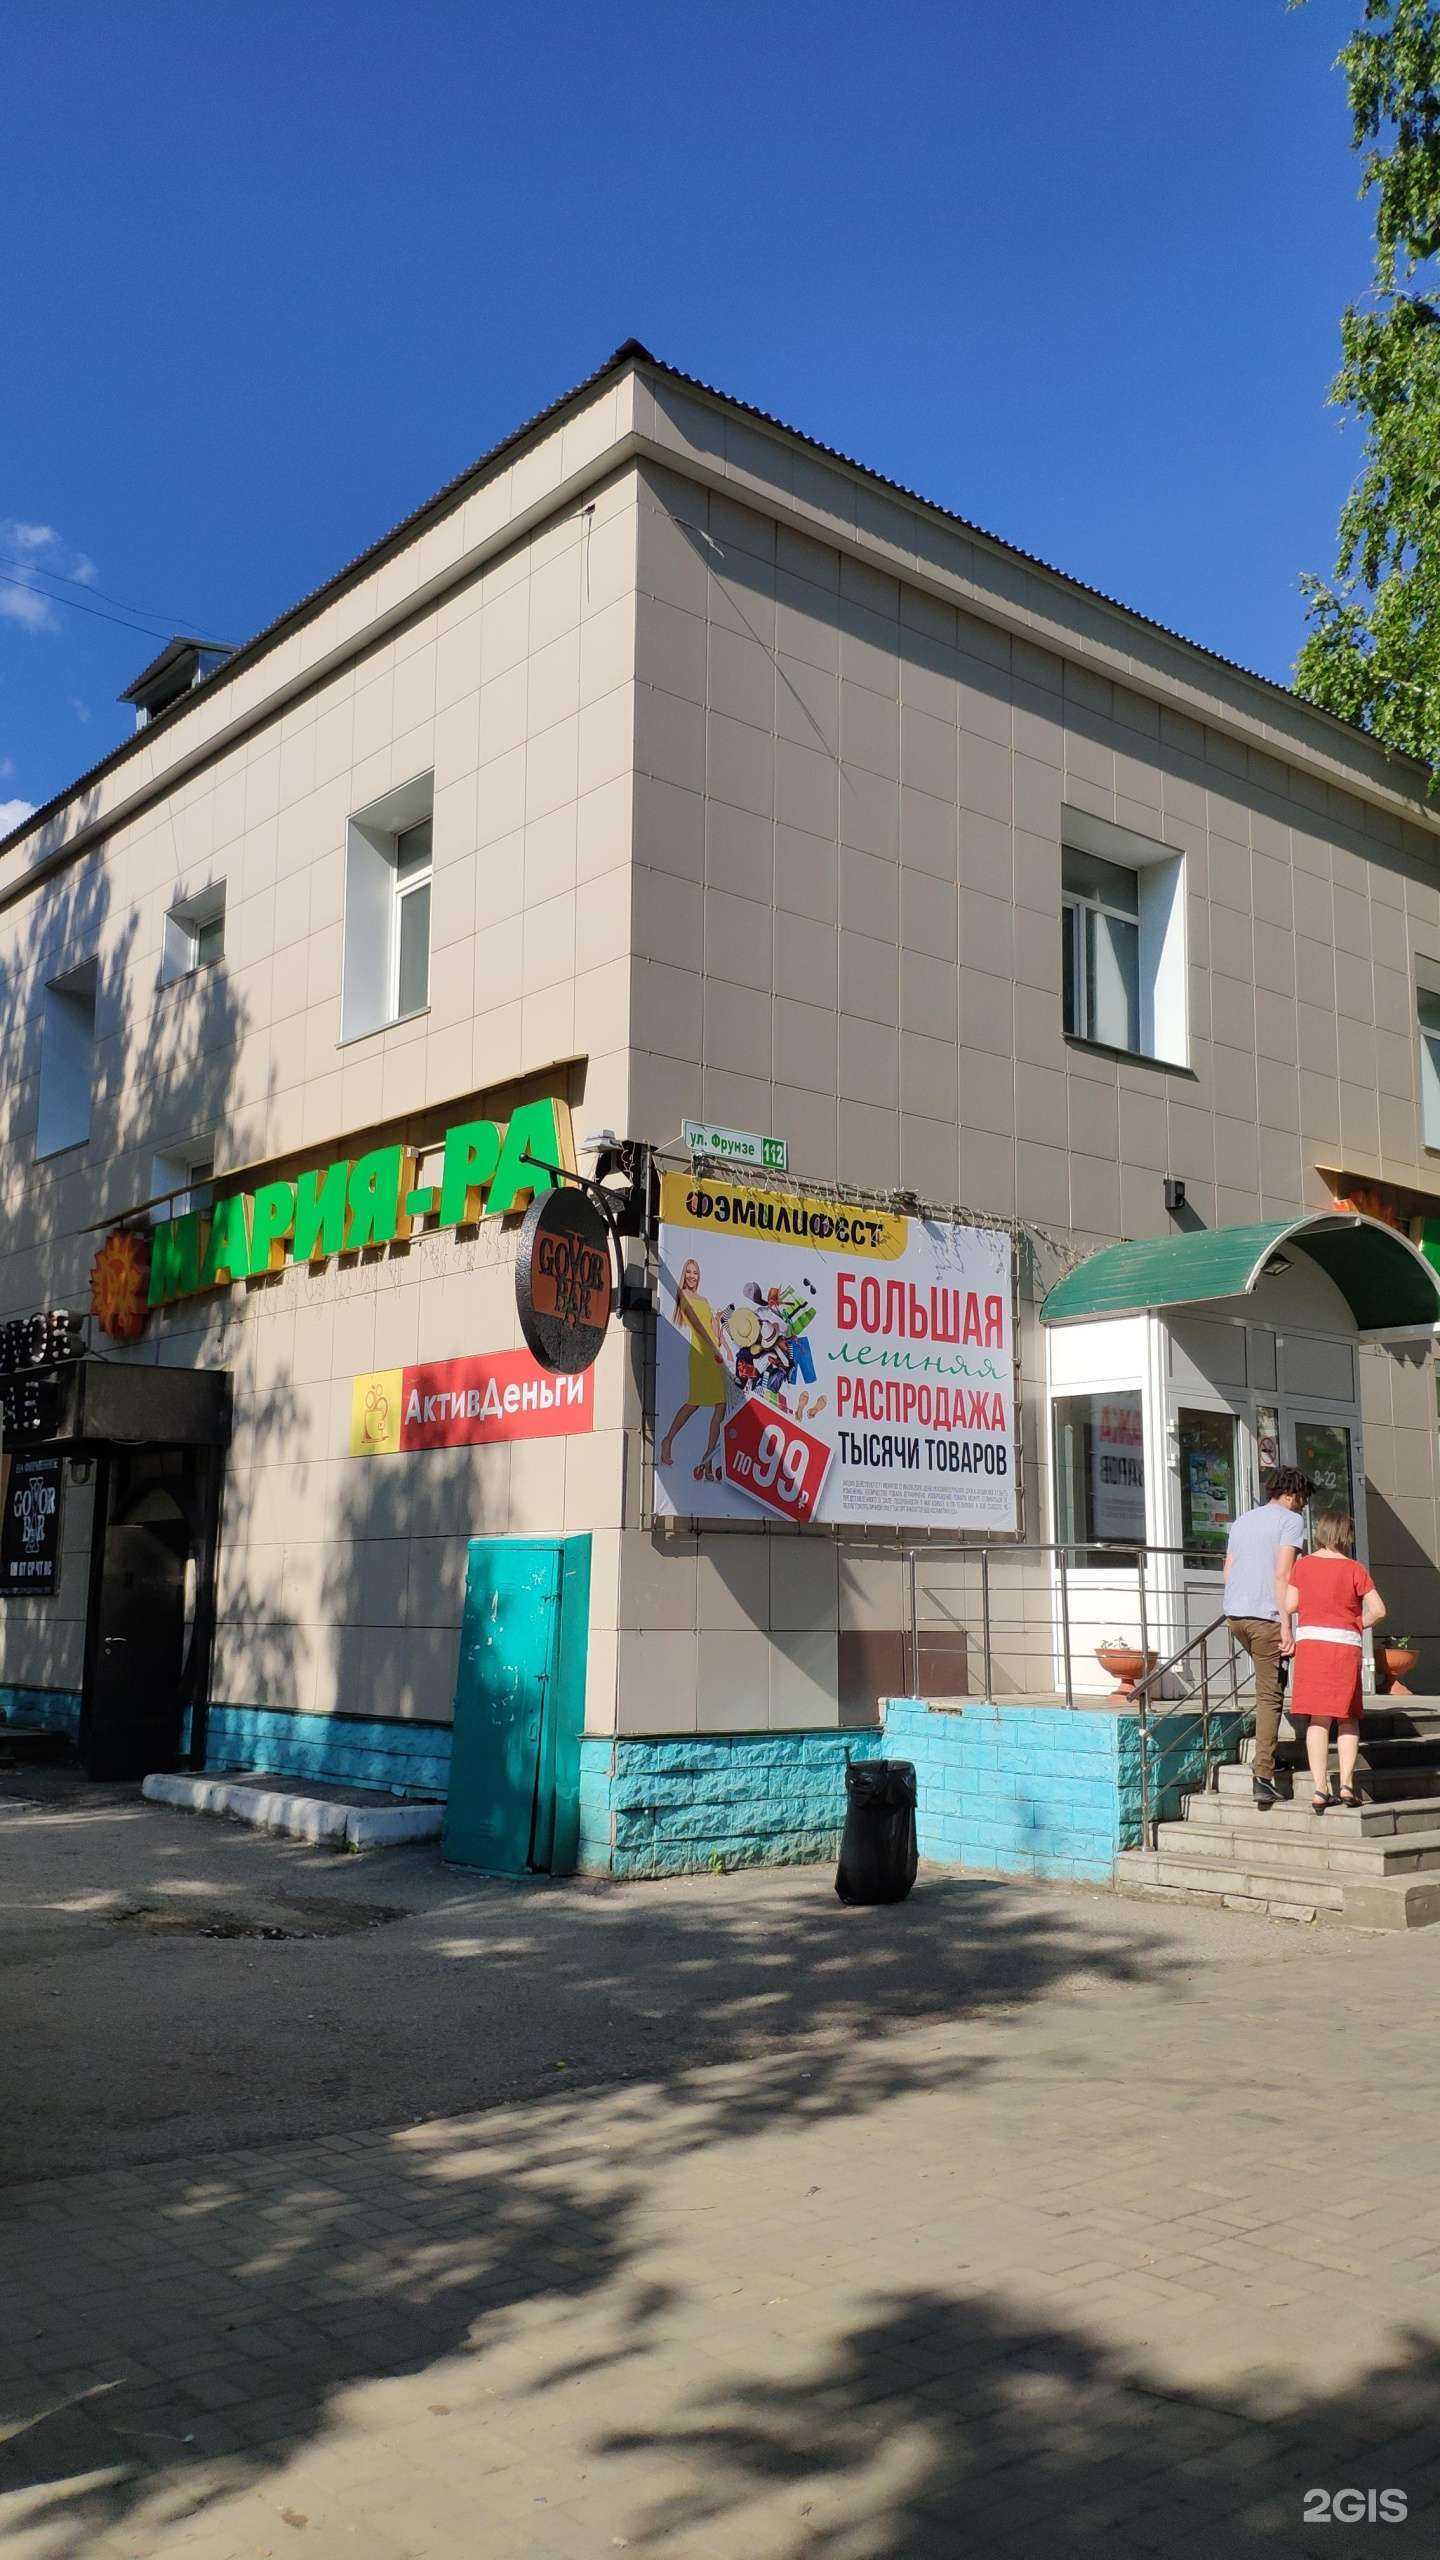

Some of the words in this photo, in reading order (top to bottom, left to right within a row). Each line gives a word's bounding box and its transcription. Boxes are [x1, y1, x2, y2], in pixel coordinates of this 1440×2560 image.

[689, 1131, 708, 1148] ул.
[711, 1132, 756, 1156] Фрунзе
[763, 1142, 785, 1166] 112
[147, 1096, 562, 1306] МАРИЯ-РА
[539, 1231, 605, 1292] GOVOR
[836, 1271, 1004, 1350] БОЛЬШАЯ
[827, 1342, 1008, 1380] летняя
[404, 1374, 585, 1425] АктивДеньги
[836, 1375, 1006, 1433] РАСПРОДАЖА
[838, 1430, 920, 1470] ТЫСЯЧИ
[924, 1438, 1008, 1476] ТОВАРОВ
[13, 1477, 56, 1518] GOVOR
